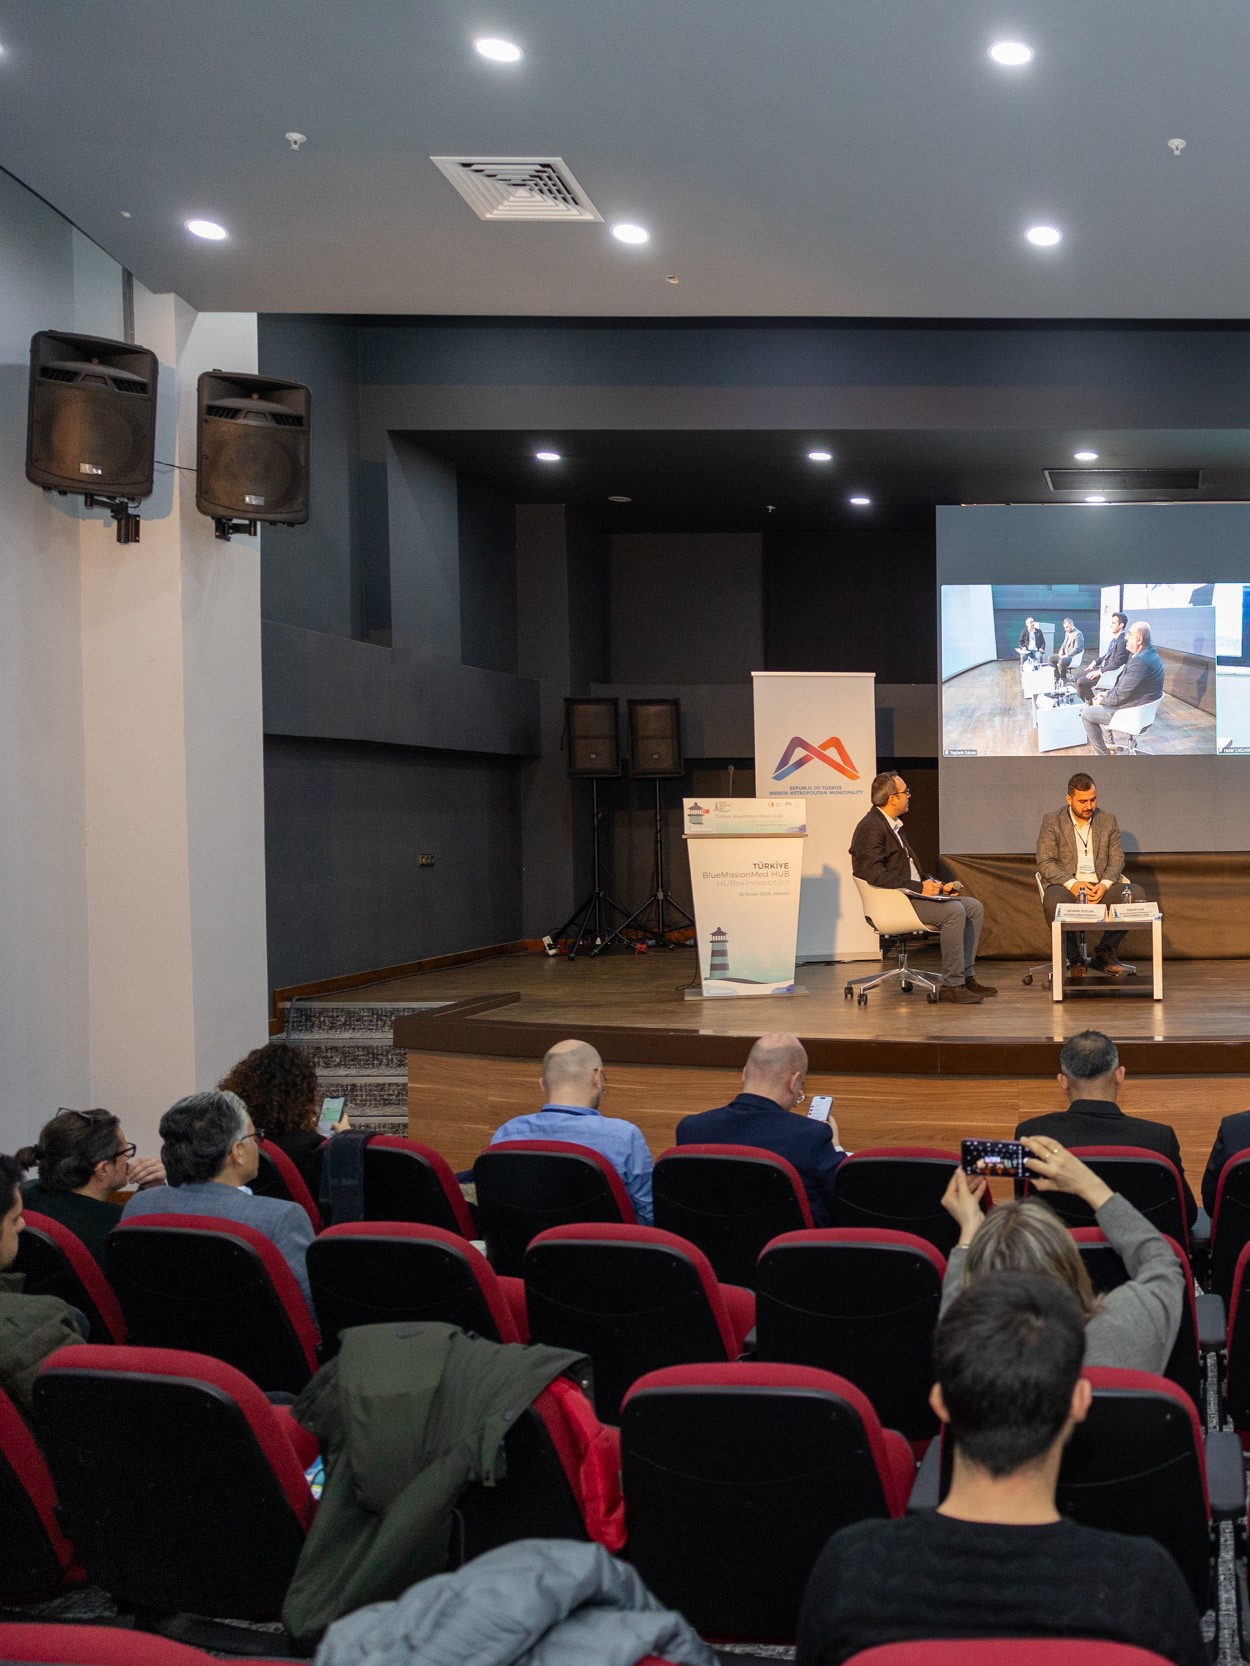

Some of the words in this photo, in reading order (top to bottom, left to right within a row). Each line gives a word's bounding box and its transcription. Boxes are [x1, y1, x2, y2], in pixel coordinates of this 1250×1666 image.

[752, 861, 789, 870] TÜRKİYE
[702, 871, 769, 879] BlueMissionMed
[771, 870, 790, 878] HUB
[716, 879, 790, 887] HUBs4Innovation
